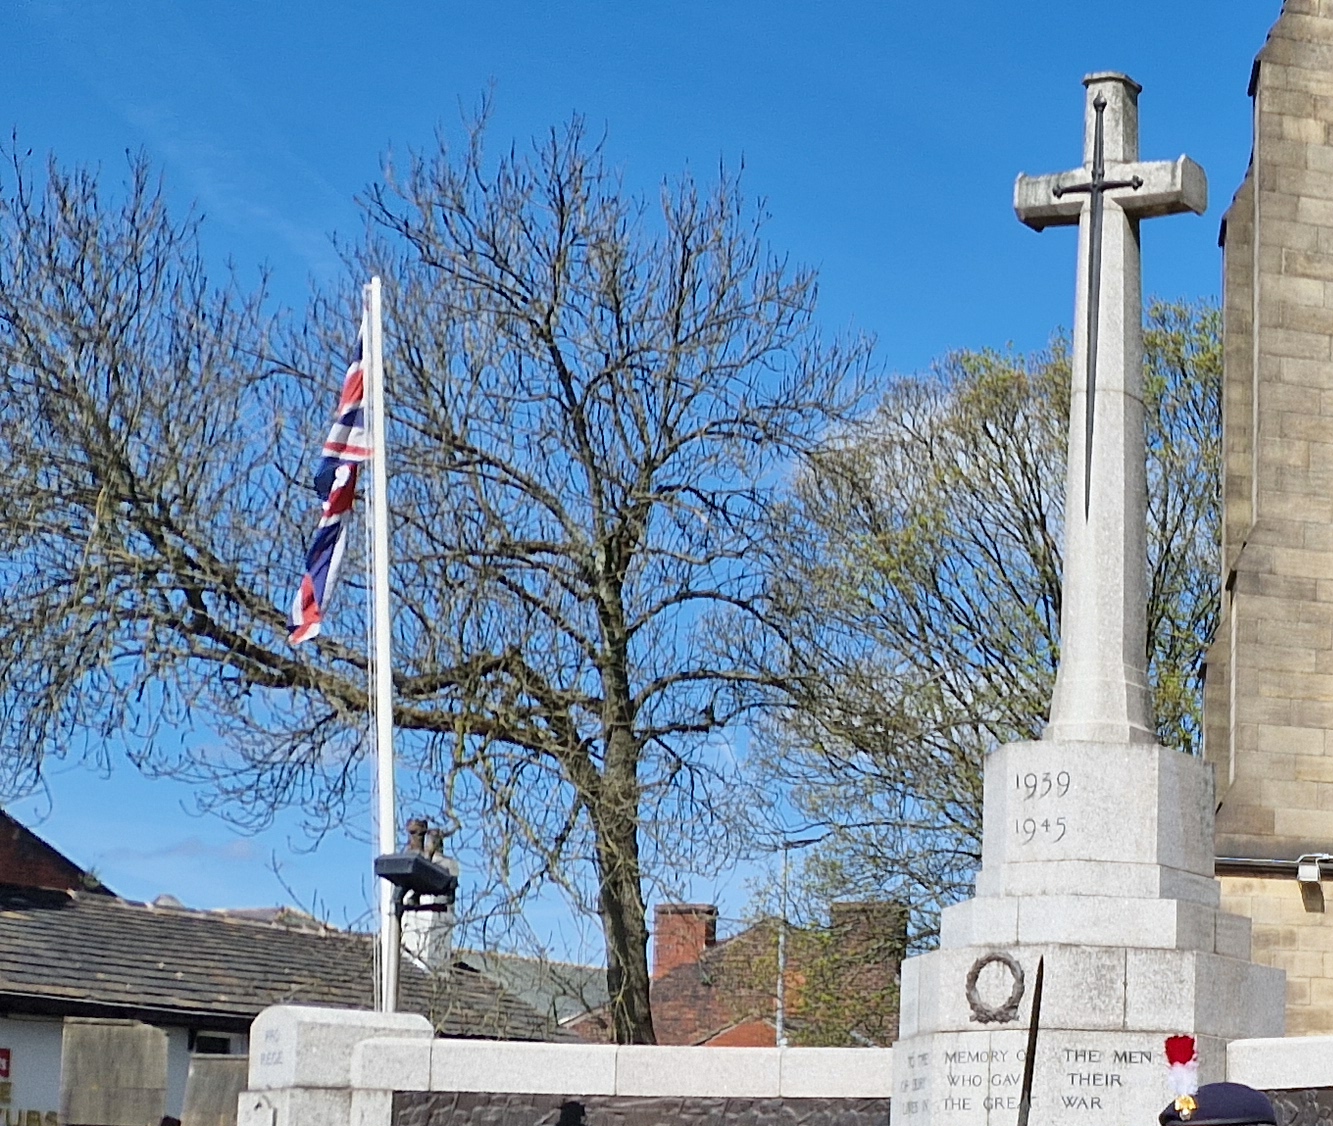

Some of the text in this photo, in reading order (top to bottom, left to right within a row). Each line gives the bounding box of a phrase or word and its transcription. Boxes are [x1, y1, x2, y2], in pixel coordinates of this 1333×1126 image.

[1016, 770, 1071, 801] 1939
[1015, 817, 1067, 846] 1945
[944, 1050, 1009, 1064] MEMORY
[1063, 1048, 1100, 1062] THE
[1113, 1050, 1152, 1064] MEN
[947, 1072, 1123, 1087] WHO GAV THEIR
[943, 1097, 972, 1110] THE
[1061, 1096, 1103, 1110] WAR
